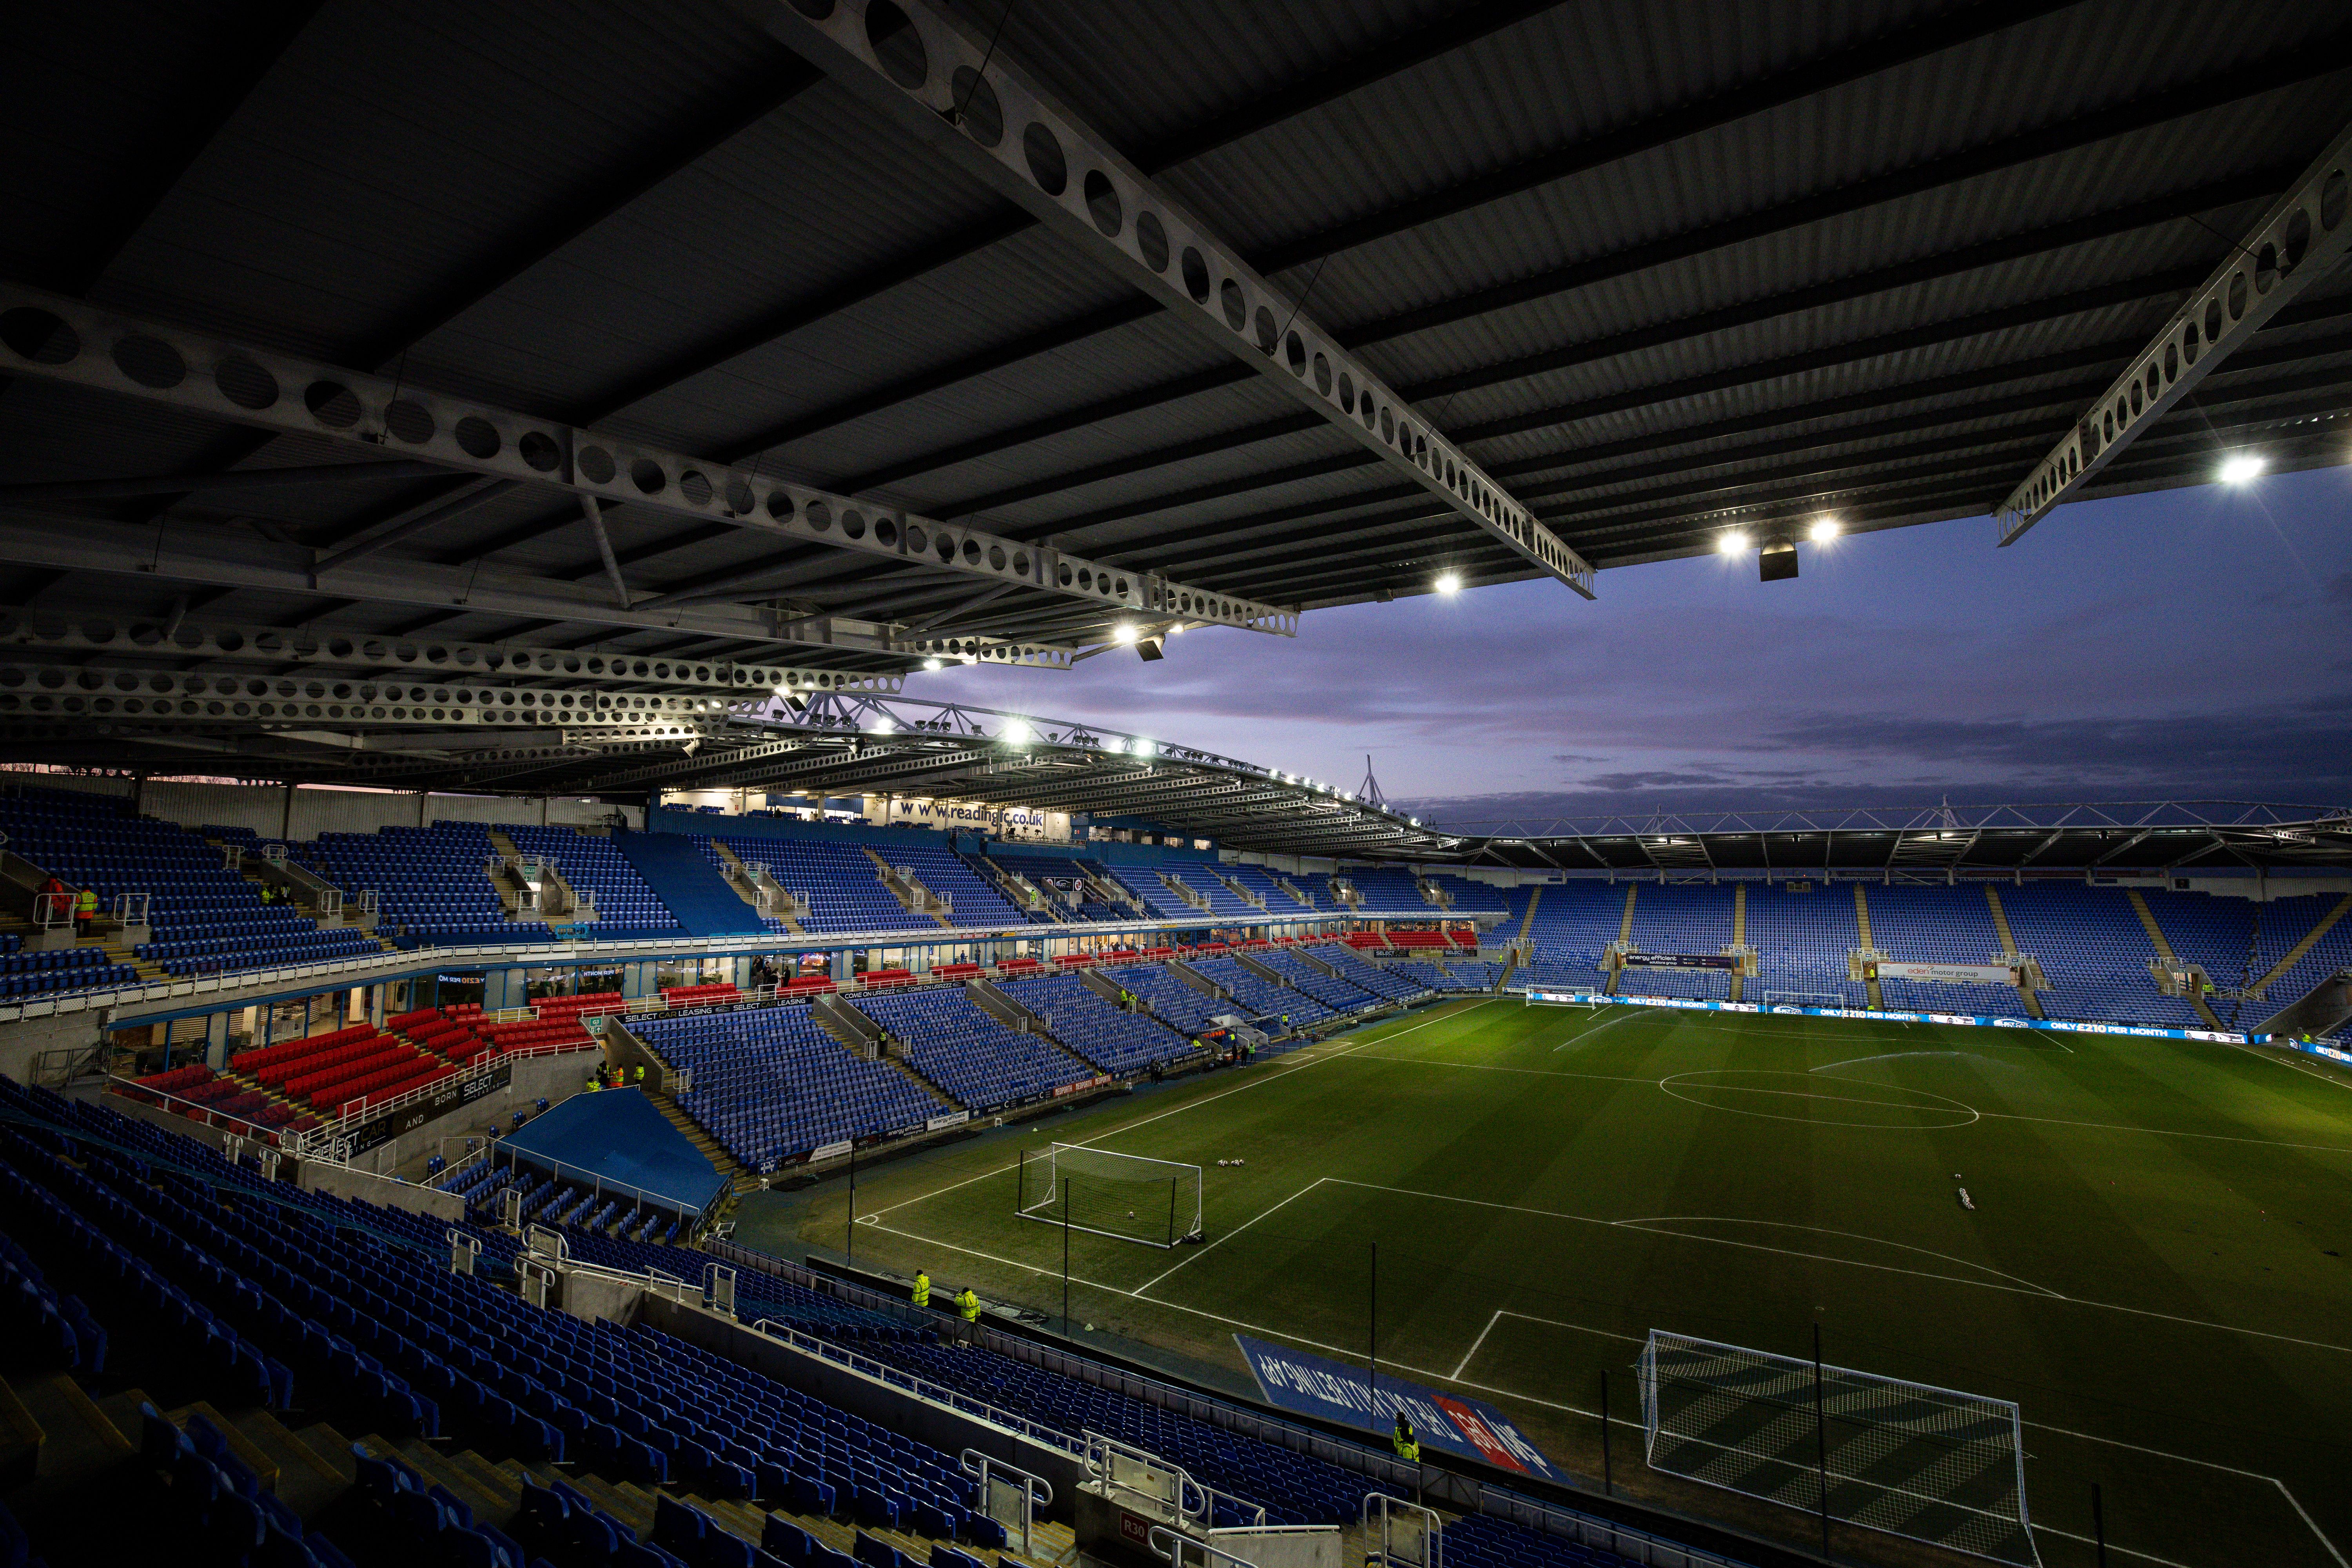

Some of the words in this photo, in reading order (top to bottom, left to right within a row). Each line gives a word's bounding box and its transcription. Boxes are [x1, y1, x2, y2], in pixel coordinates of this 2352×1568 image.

[733, 1003, 760, 1011] SELECT
[777, 998, 806, 1006] LEASING
[625, 1013, 657, 1022] SELECT
[678, 1007, 712, 1016] LEASING
[2076, 1023, 2107, 1033] £210
[2130, 1028, 2168, 1036] MONTH
[2316, 1045, 2328, 1055] ONLY
[2341, 1052, 2350, 1062] PER
[464, 1074, 492, 1097] SELECT
[494, 1067, 509, 1083] CAR
[474, 1082, 499, 1098] LEASING
[435, 1090, 457, 1106] BORN
[361, 1120, 387, 1142] CAR
[405, 1114, 424, 1130] AND
[904, 1123, 924, 1131] efficient
[1258, 1354, 1290, 1388] APP
[1281, 1361, 1354, 1408] BETTING
[1337, 1377, 1391, 1421] NO.1
[1374, 1388, 1428, 1432] UK'S
[1405, 1397, 1464, 1443] THE
[1448, 1410, 1519, 1466] bet
[1124, 1519, 1145, 1538] R30
